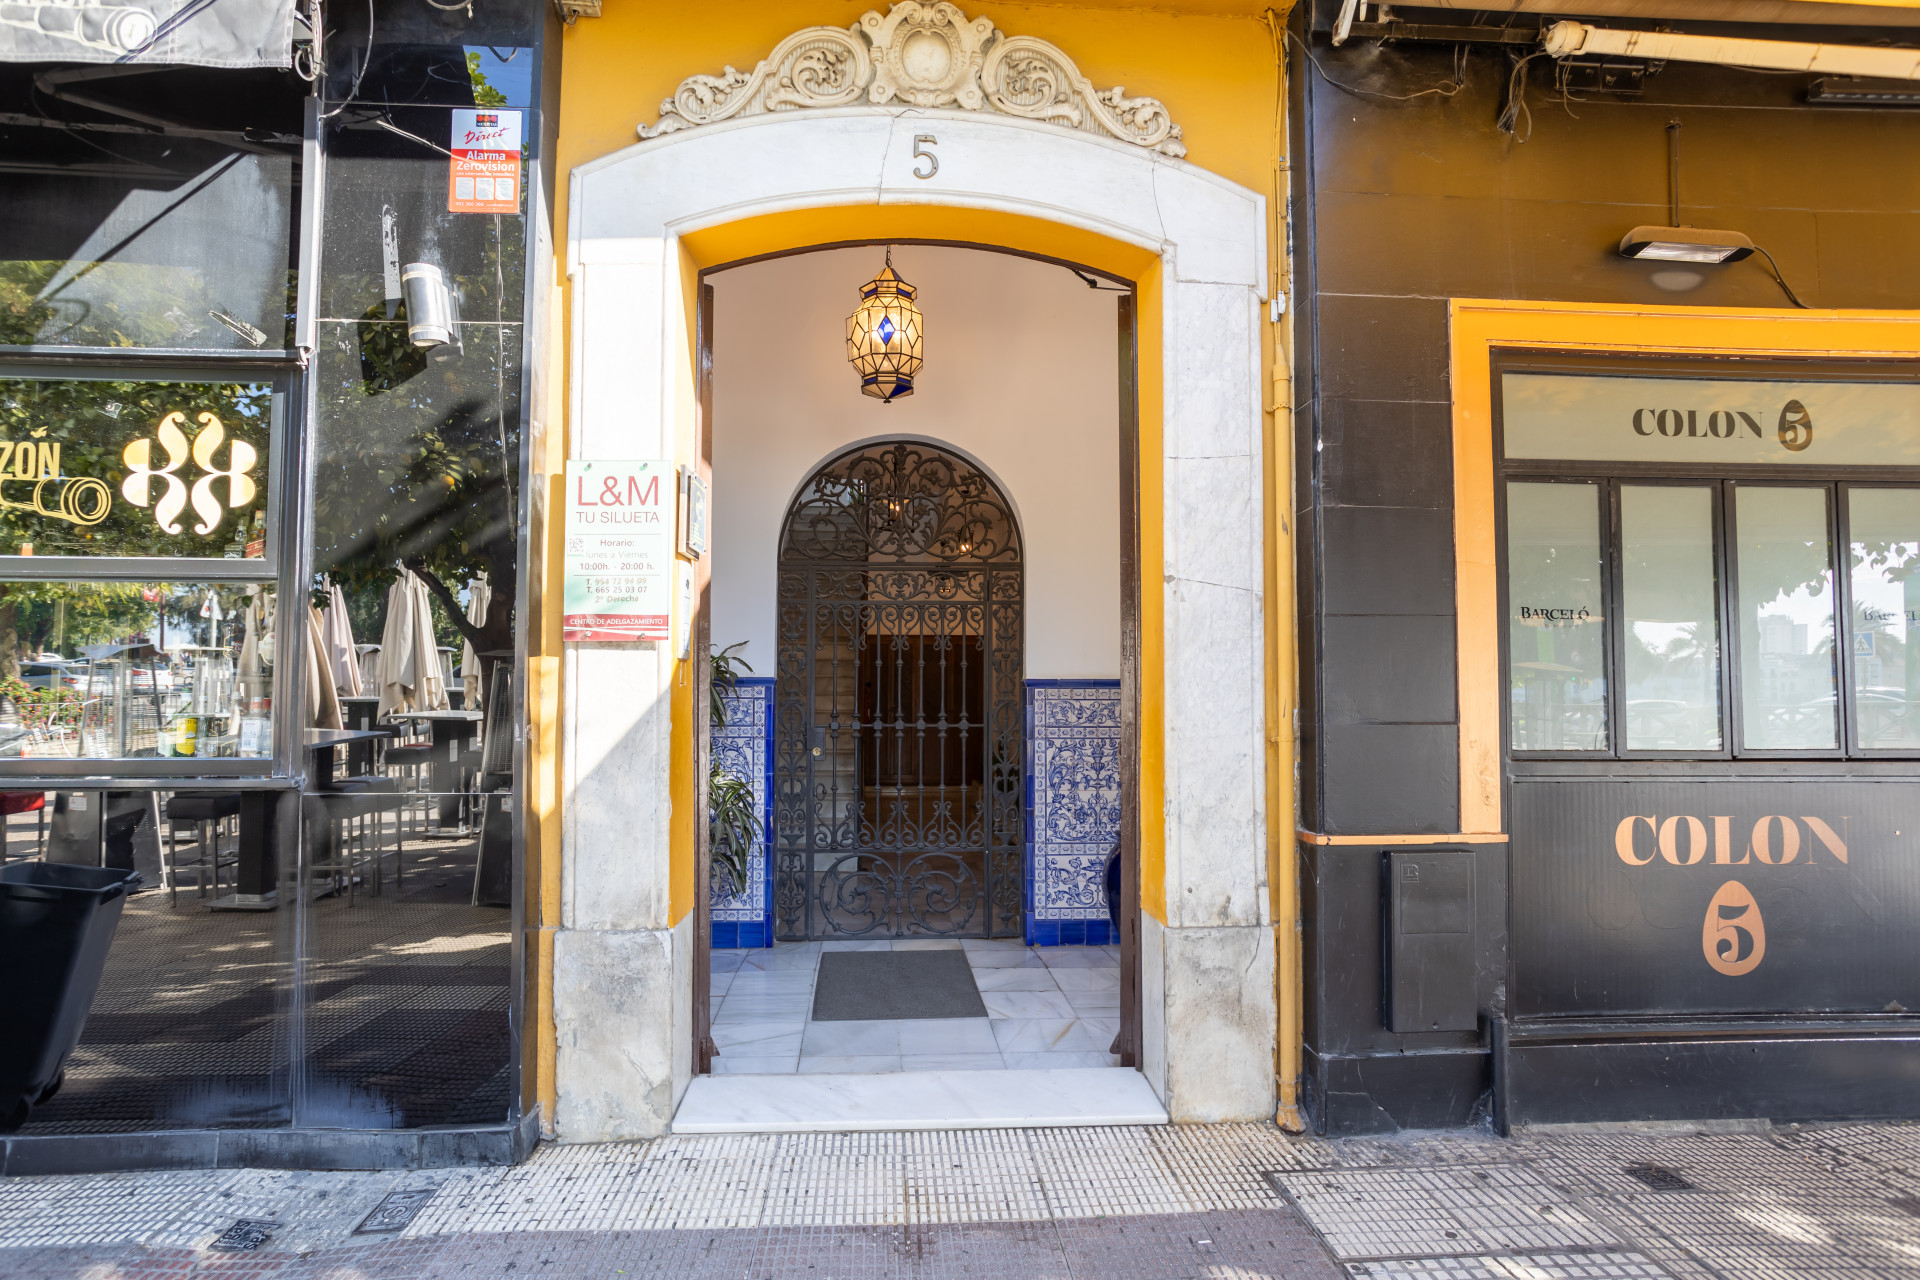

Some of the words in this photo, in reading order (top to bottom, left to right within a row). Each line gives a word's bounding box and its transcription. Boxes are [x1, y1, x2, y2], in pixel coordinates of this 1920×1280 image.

[464, 127, 510, 144] Direct
[466, 150, 506, 161] Alarma
[913, 135, 939, 179] 5
[456, 161, 515, 172] Zerovision
[1632, 408, 1763, 439] COLON
[1782, 412, 1805, 444] 5
[578, 475, 659, 506] L&M
[576, 511, 595, 524] TU
[600, 511, 660, 524] SILUETA
[600, 539, 635, 547] Horario:
[618, 551, 649, 559] Viernes
[620, 562, 644, 571] 20:00
[613, 577, 622, 585] 72
[586, 586, 593, 594] T.
[607, 595, 639, 603] Derecha
[1614, 814, 1853, 866] COLON
[1715, 904, 1754, 963] 5
